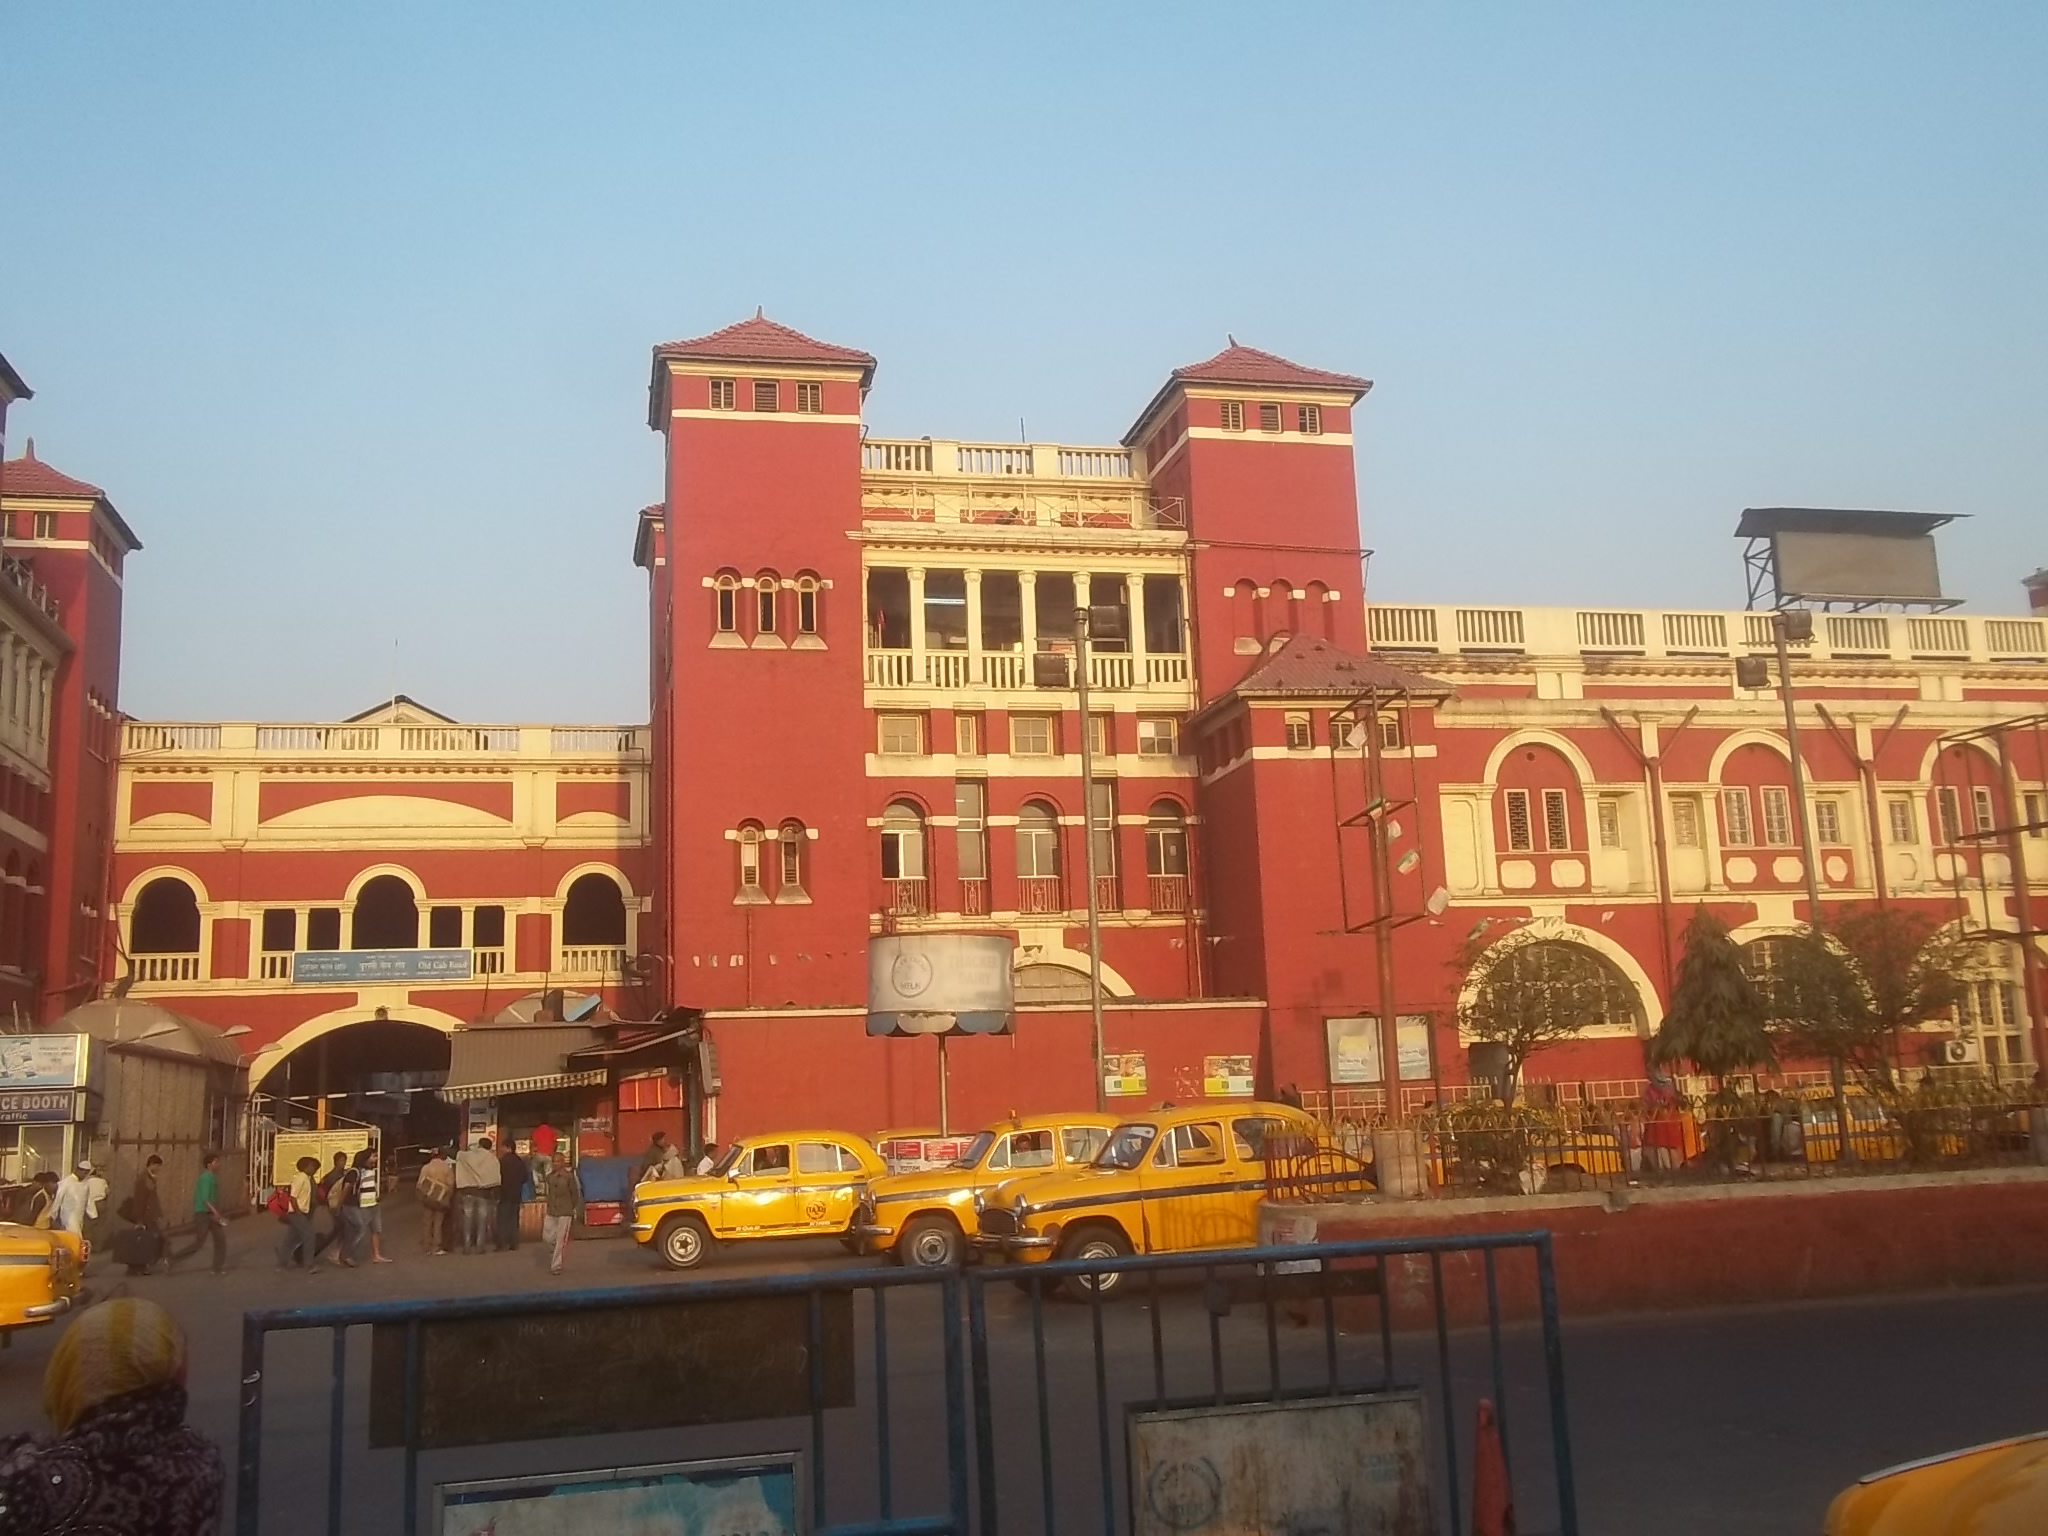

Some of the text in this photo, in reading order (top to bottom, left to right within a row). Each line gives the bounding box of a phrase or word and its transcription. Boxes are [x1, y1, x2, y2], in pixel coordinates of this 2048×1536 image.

[418, 960, 468, 970] Old Cab Road
[22, 1094, 69, 1110] BOOTH
